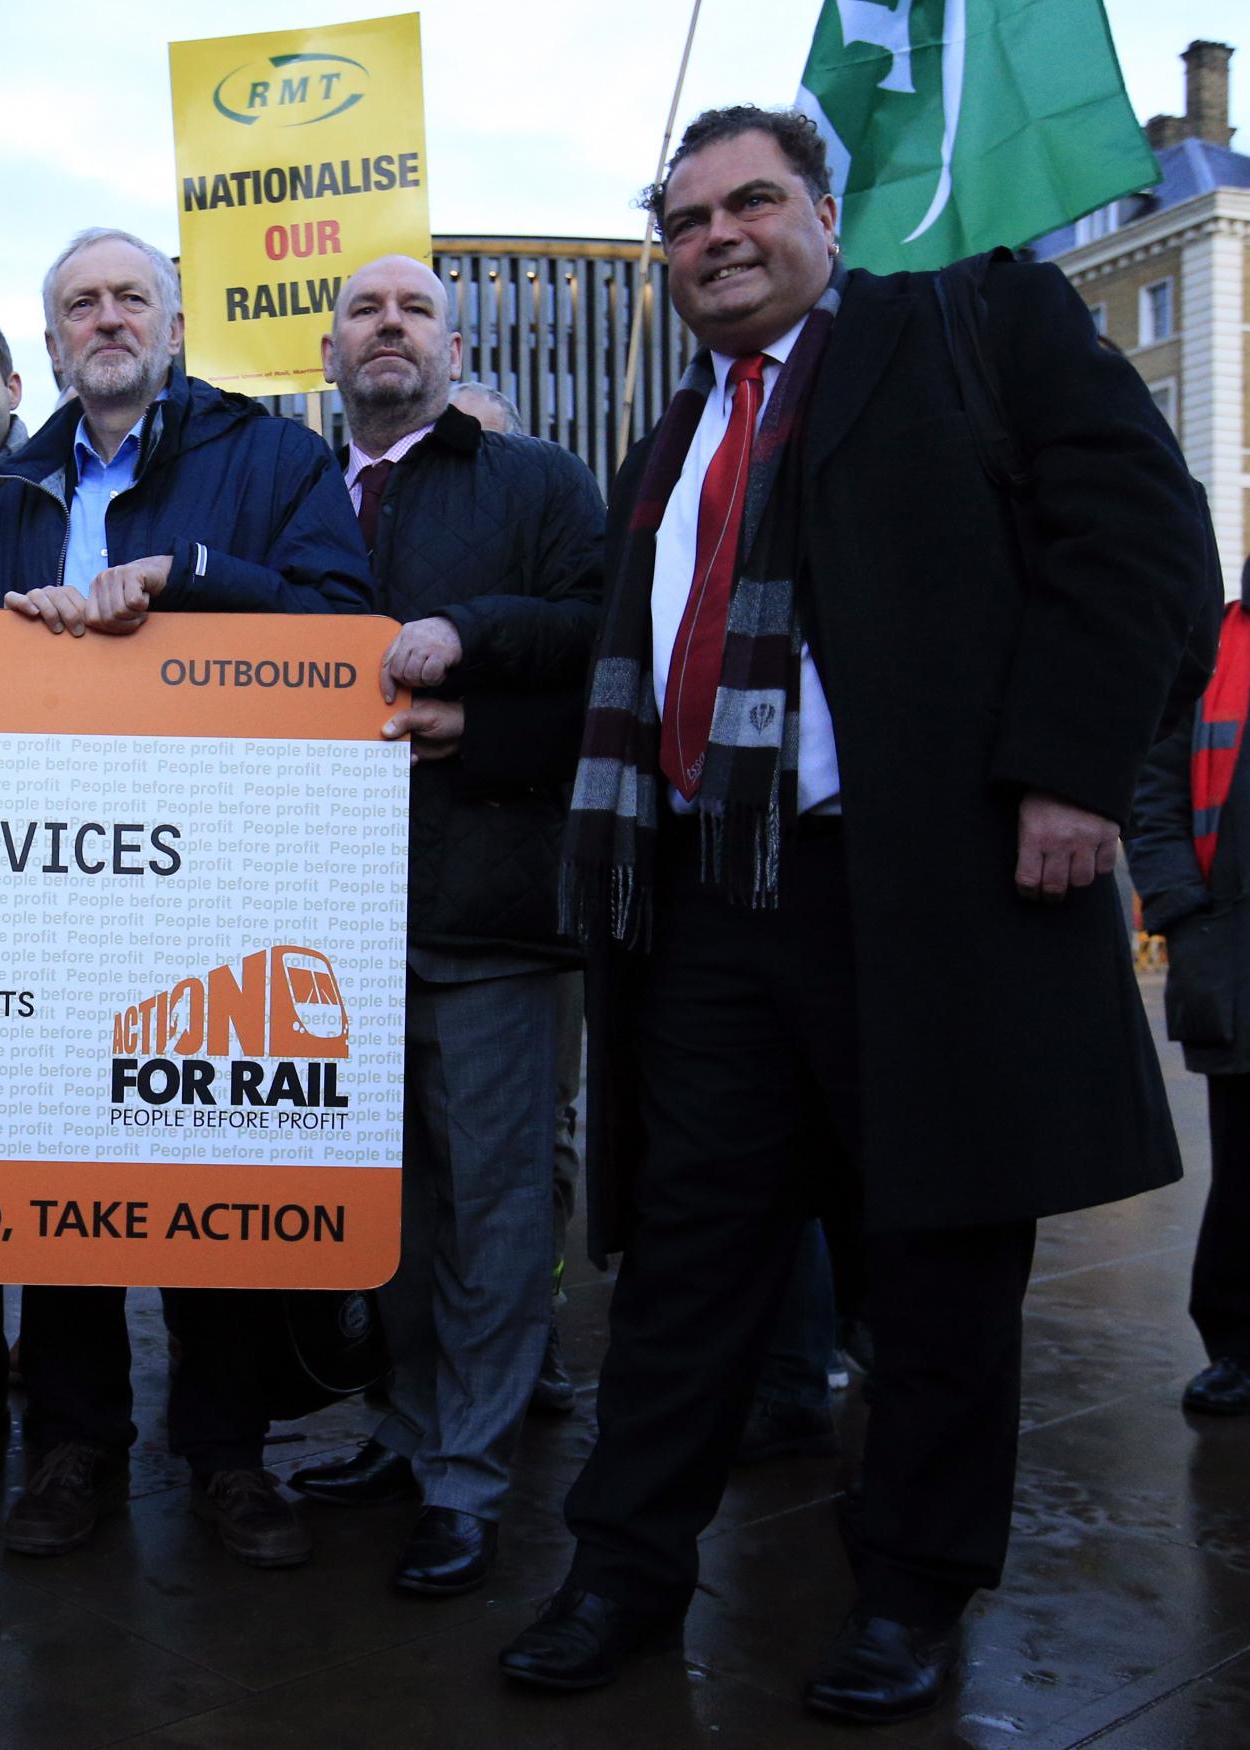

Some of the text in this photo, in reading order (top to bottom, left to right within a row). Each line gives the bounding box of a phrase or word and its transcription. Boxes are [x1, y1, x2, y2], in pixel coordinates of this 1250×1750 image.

[247, 72, 341, 109] RMT
[183, 152, 421, 212] NATIONALISE
[264, 220, 342, 261] OUR
[161, 659, 357, 688] OUTBOUND
[17, 737, 61, 754] profit
[71, 738, 127, 756] People
[133, 739, 185, 753] before
[191, 741, 235, 758] profit
[245, 742, 301, 759] People
[307, 743, 359, 757] before
[365, 745, 408, 762] profit
[46, 757, 98, 771] before
[104, 758, 147, 775] profit
[158, 759, 214, 777] People
[219, 761, 272, 775] before
[277, 762, 321, 779] profit
[332, 763, 387, 781] People
[16, 777, 60, 795] profit
[70, 779, 127, 796] People
[132, 780, 184, 794] before
[190, 781, 234, 799] profit
[244, 783, 300, 800] People
[306, 784, 358, 798] before
[364, 785, 407, 802] profit
[45, 797, 97, 811] before
[103, 798, 146, 816] profit
[157, 799, 213, 817] People
[219, 801, 271, 815] before
[277, 802, 320, 819] profit
[331, 803, 387, 821] People
[218, 839, 270, 853] before
[276, 840, 319, 858] profit
[330, 841, 386, 859] People
[155, 914, 211, 931] People
[216, 915, 268, 929] before
[274, 916, 318, 934] profit
[328, 917, 384, 935] People
[114, 950, 267, 1056] ACTION
[112, 1057, 348, 1107] FOR RAIL
[111, 1109, 348, 1130] PEOPLE BEFORE PROFIT
[37, 1142, 89, 1156] before
[95, 1143, 139, 1160] profit
[149, 1144, 206, 1162] People
[211, 1145, 263, 1159] before
[269, 1147, 313, 1164] profit
[324, 1148, 380, 1165] People
[30, 1200, 148, 1238] TAKE
[165, 1203, 344, 1242] ACTION
